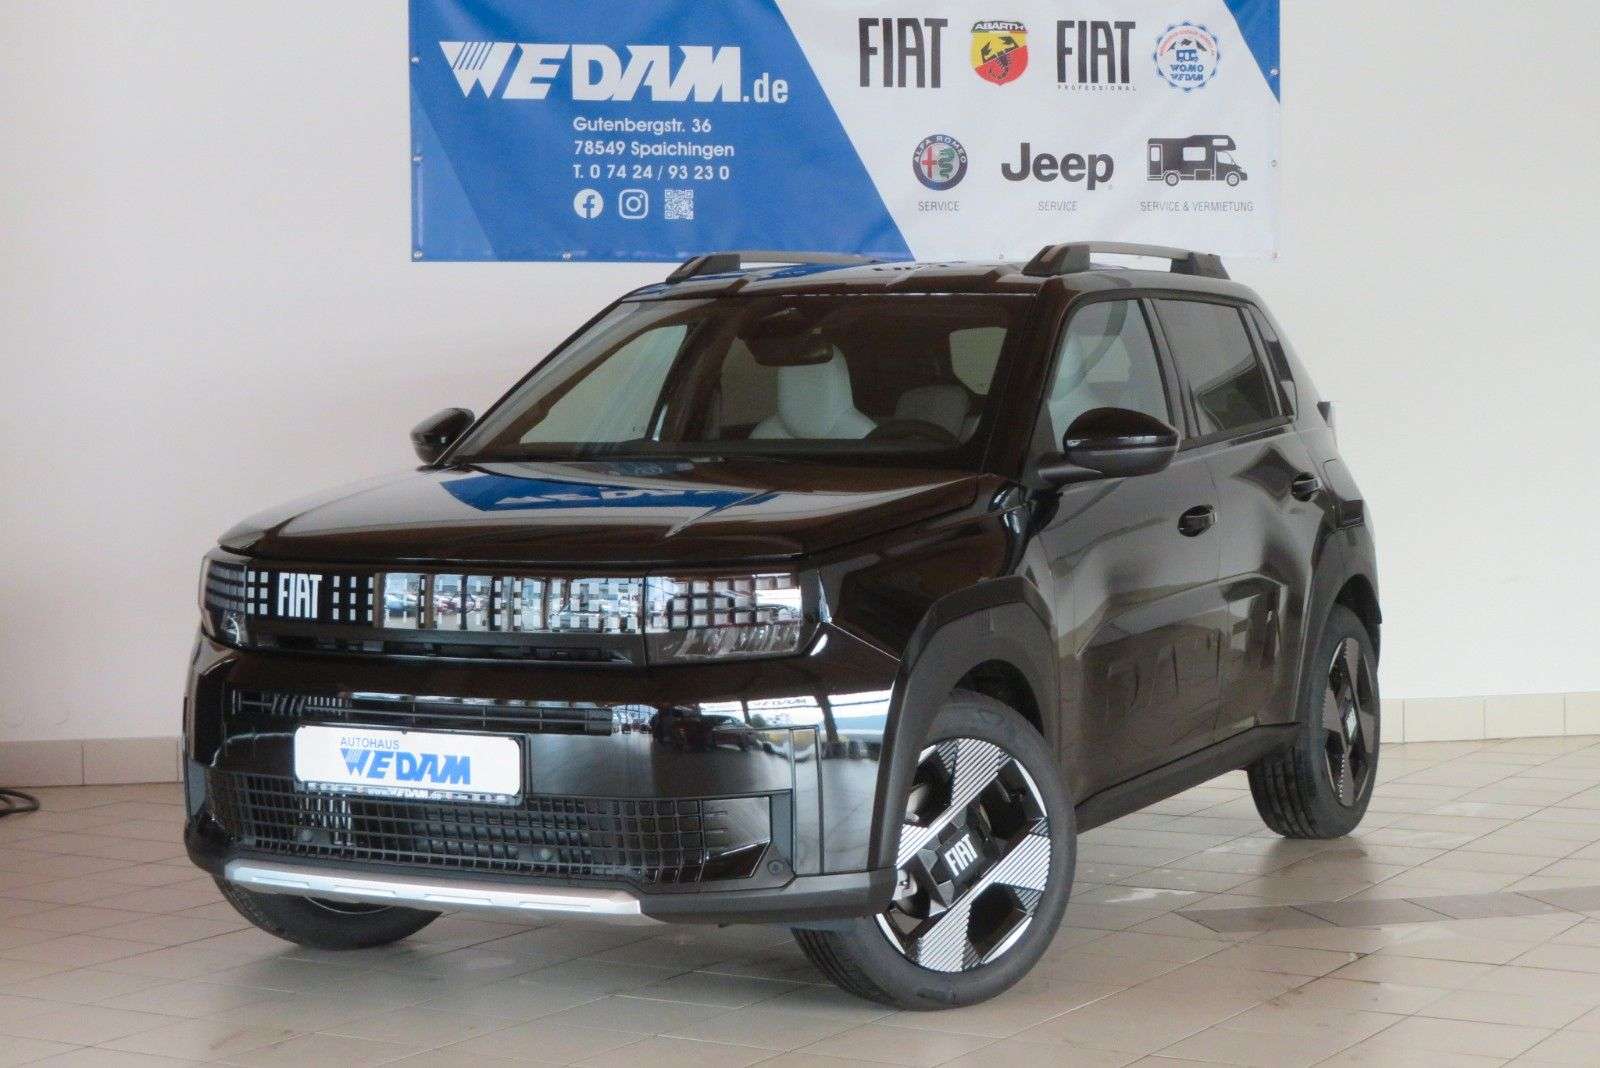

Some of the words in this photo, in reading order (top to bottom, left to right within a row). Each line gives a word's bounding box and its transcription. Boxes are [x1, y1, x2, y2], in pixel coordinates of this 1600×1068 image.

[975, 22, 1025, 31] ABARTH
[859, 18, 948, 88] FIAT
[1057, 20, 1136, 83] FIAT
[573, 116, 686, 135] Gutenbergstr.
[691, 118, 712, 134] 36
[574, 140, 625, 156] 78549
[630, 141, 734, 159] Spaichingen
[914, 138, 932, 162] ALFA
[936, 135, 967, 163] ROMEO
[573, 164, 584, 179] T.
[590, 164, 600, 179] 0
[607, 164, 627, 179] 74
[632, 164, 652, 179] 24
[668, 164, 688, 180] 93
[694, 165, 714, 180] 23
[719, 165, 730, 180] 0
[1001, 142, 1114, 190] Jeep
[918, 201, 960, 211] SERVICE
[1038, 201, 1078, 211] SERVICE
[1140, 201, 1179, 211] SERVICE
[1183, 201, 1190, 211] &
[1194, 201, 1254, 212] VERMIETUNG
[277, 573, 323, 619] FIAT
[340, 736, 400, 750] AUTOHAUS
[340, 748, 471, 785] WEDAM
[944, 833, 978, 877] FIAT
